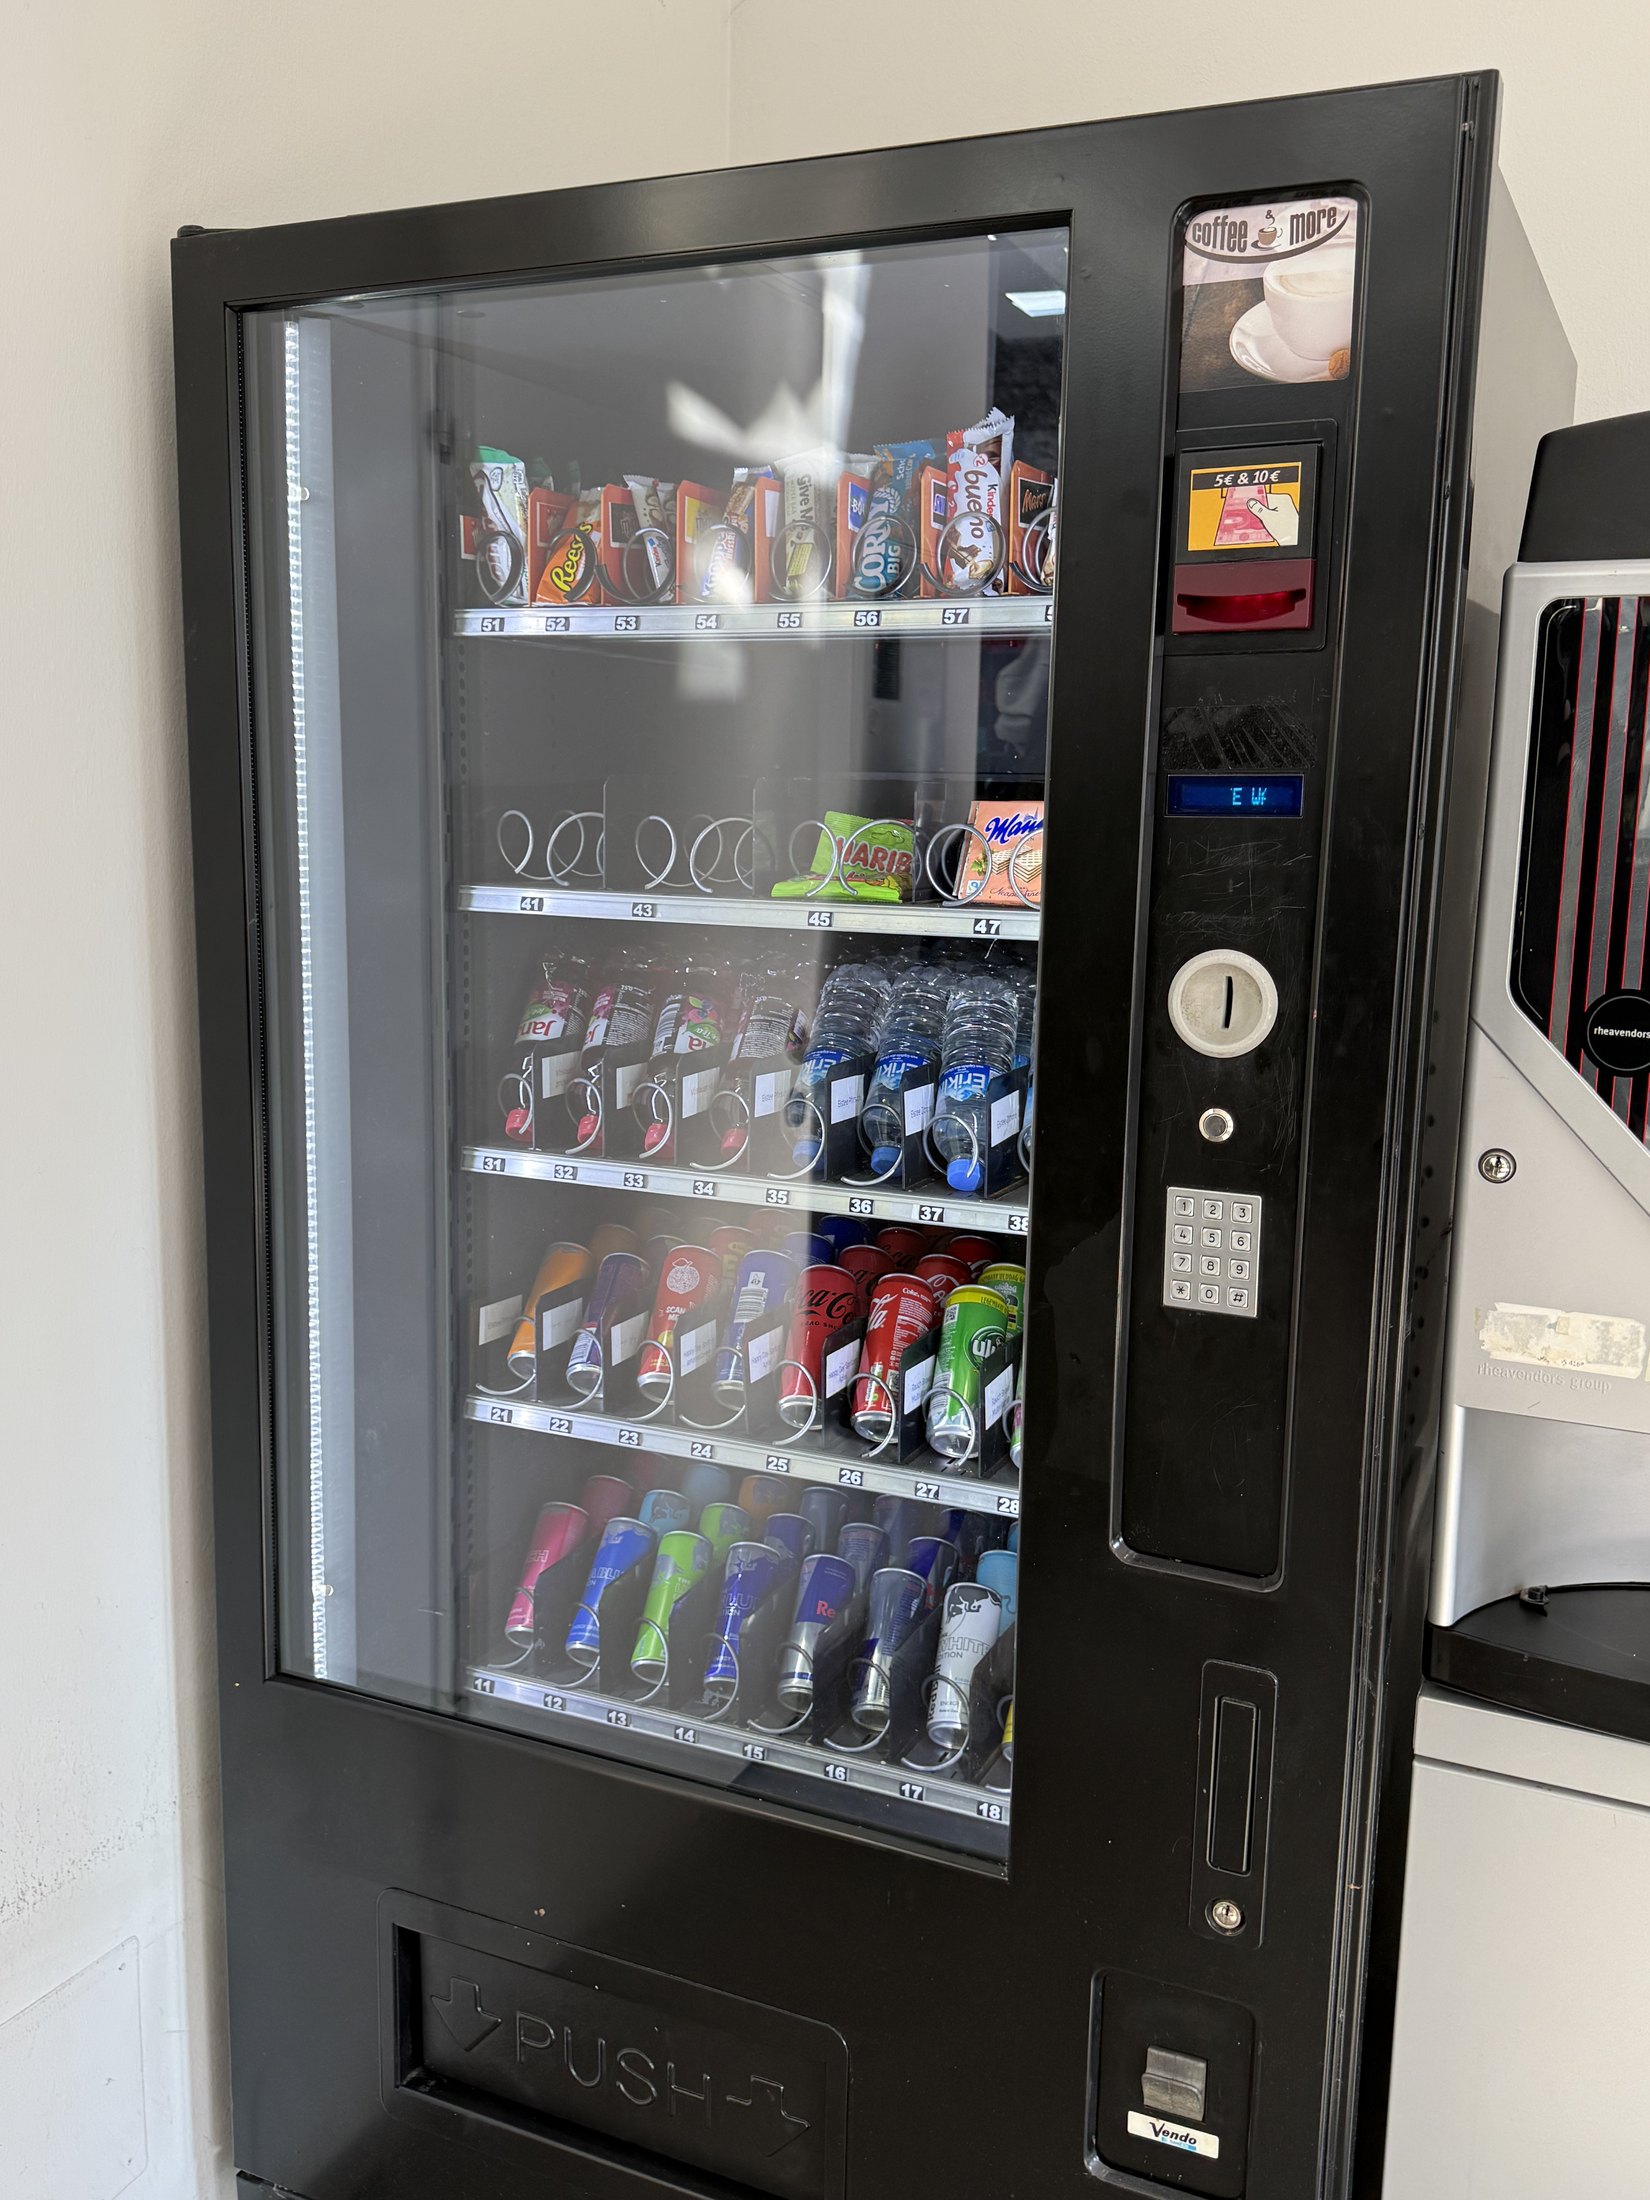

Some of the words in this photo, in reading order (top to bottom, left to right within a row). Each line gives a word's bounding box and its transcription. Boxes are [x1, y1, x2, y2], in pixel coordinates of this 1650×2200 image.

[1192, 215, 1248, 252] coffee
[1289, 206, 1338, 246] more
[796, 473, 813, 506] Give
[1214, 473, 1234, 487] 5€
[1237, 472, 1249, 485] &
[964, 470, 988, 540] bueno
[887, 545, 901, 575] BIG
[482, 617, 501, 632] 51
[545, 617, 566, 631] 52
[615, 616, 637, 630] 53
[696, 615, 718, 629] 54
[778, 614, 800, 627] 55
[855, 611, 879, 625] 56
[943, 609, 968, 623] 57
[836, 836, 913, 874] HARIB
[520, 897, 541, 911] 41
[633, 904, 653, 917] 43
[808, 913, 831, 926] 45
[974, 920, 1000, 934] 47
[518, 1020, 557, 1037] Jan
[1593, 1025, 1650, 1039] rheavendors
[483, 1158, 501, 1170] 31
[554, 1166, 574, 1179] 32
[624, 1174, 644, 1186] 33
[694, 1182, 714, 1195] 34
[767, 1190, 788, 1203] 35
[850, 1199, 872, 1214] 36
[920, 1206, 943, 1221] 37
[1009, 1216, 1029, 1231] 38
[1209, 1205, 1216, 1215] 2
[1239, 1208, 1246, 1218] 3
[1179, 1229, 1186, 1239] 4
[1208, 1233, 1215, 1243] 5
[1237, 1236, 1244, 1246] 6
[1178, 1257, 1186, 1267] 7
[1207, 1261, 1214, 1271] 8
[1236, 1264, 1243, 1274] 9
[1205, 1289, 1213, 1299] 0
[1477, 1362, 1565, 1386] rheavendors
[1569, 1377, 1611, 1394] group
[491, 1408, 509, 1421] 21
[550, 1419, 569, 1432] 22
[620, 1431, 639, 1444] 23
[691, 1444, 712, 1457] 24
[767, 1457, 788, 1471] 25
[840, 1470, 862, 1484] 26
[916, 1483, 938, 1497] 27
[999, 1498, 1019, 1512] 28
[815, 1600, 837, 1618] Re
[474, 1679, 492, 1693] 11
[544, 1695, 563, 1709] 12
[608, 1711, 627, 1725] 13
[675, 1727, 695, 1742] 14
[744, 1746, 763, 1759] 15
[826, 1765, 845, 1779] 16
[902, 1784, 924, 1798] 17
[979, 1803, 1000, 1818] 18
[516, 2009, 712, 2129] PUSH
[1149, 2121, 1197, 2145] Vendo
